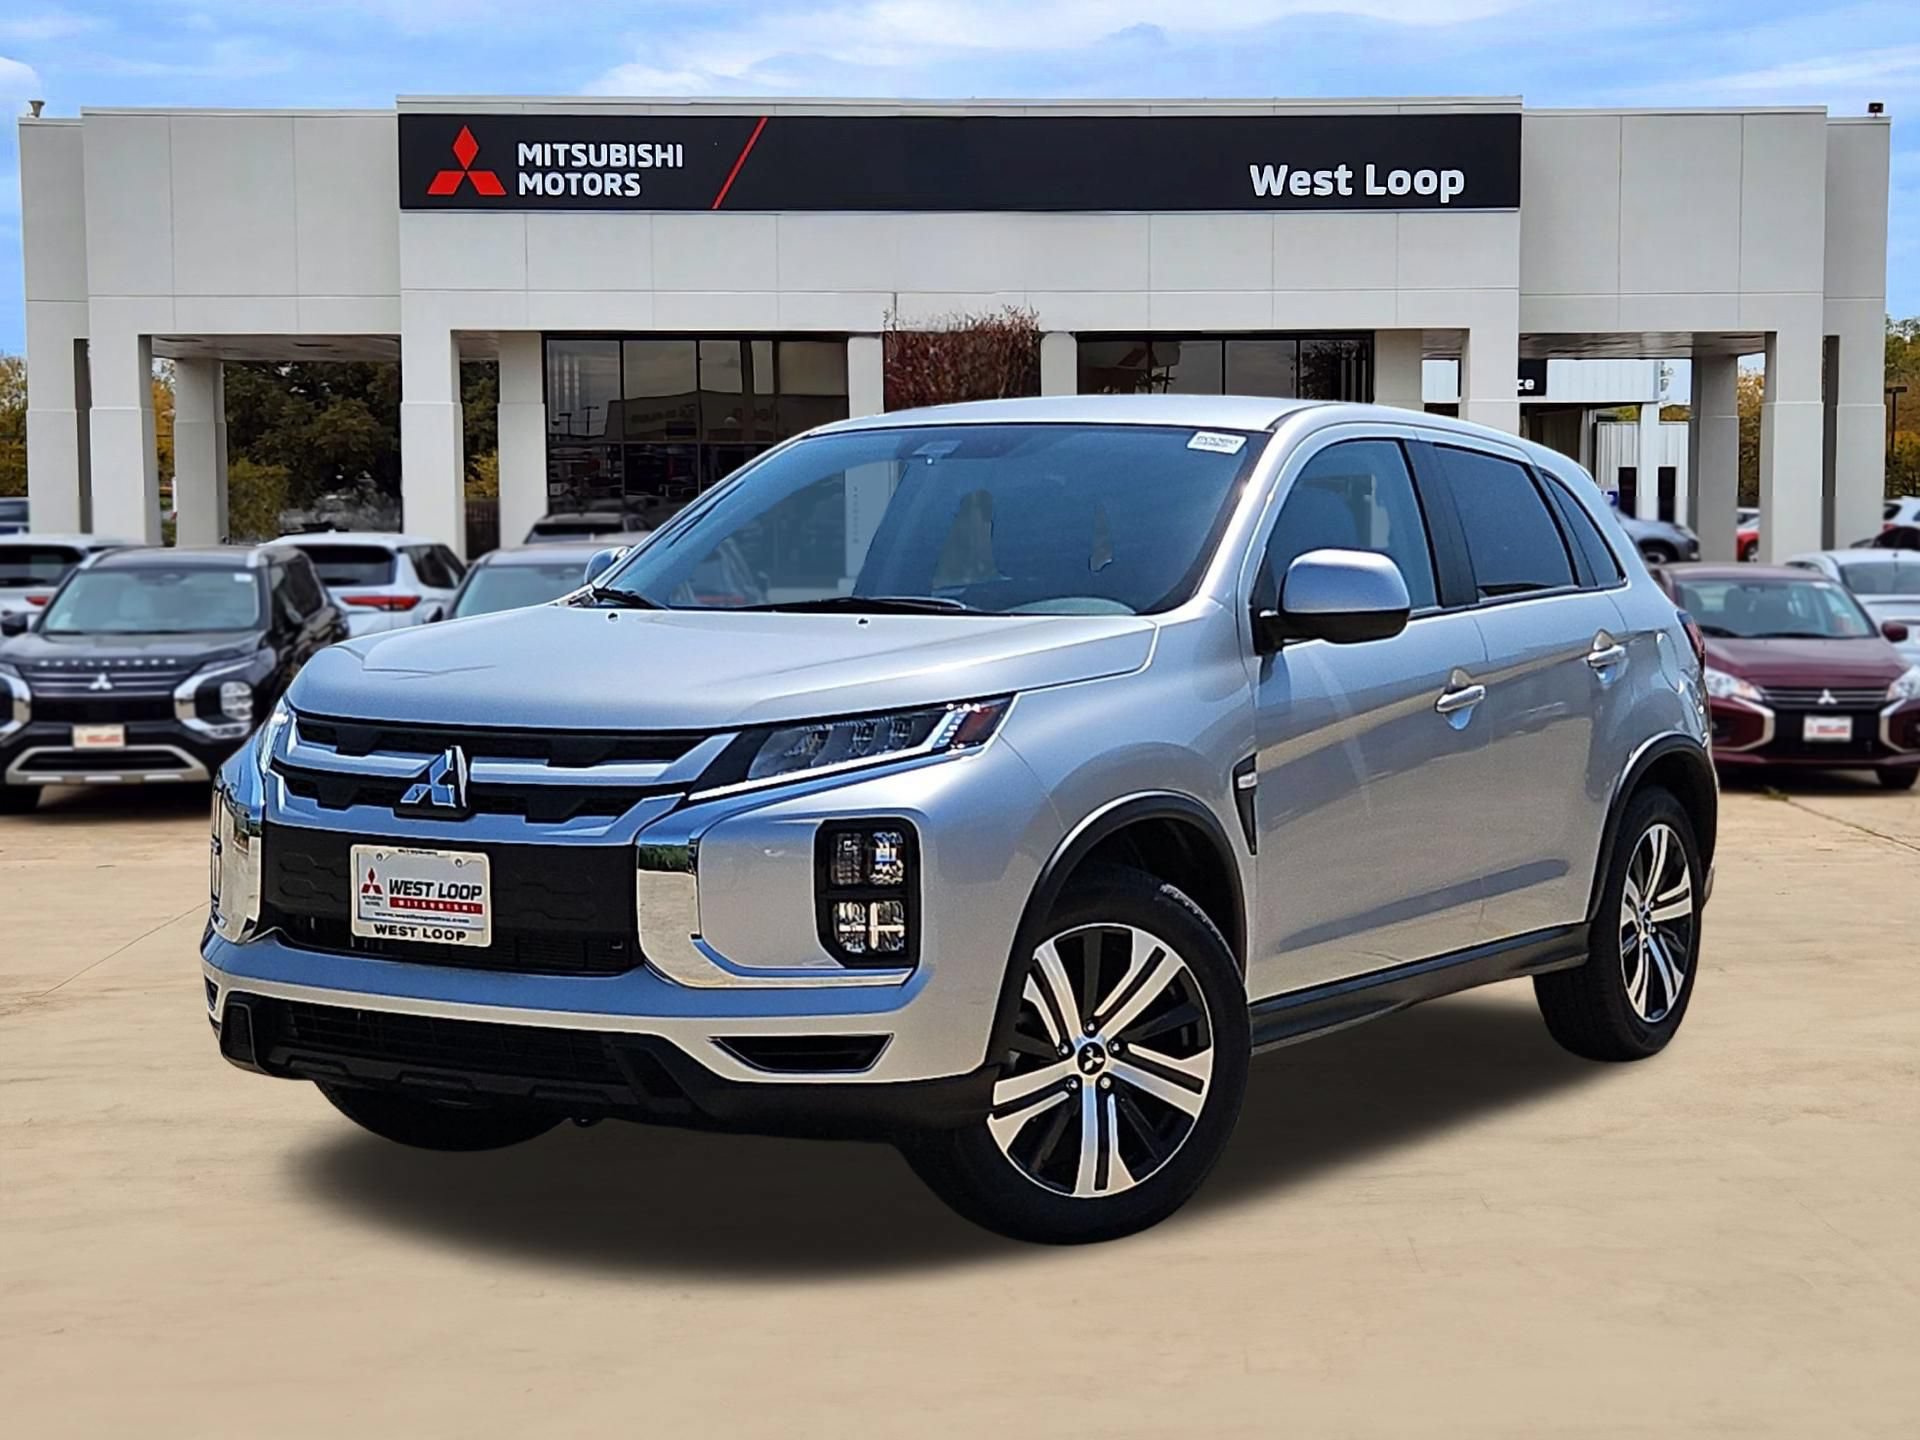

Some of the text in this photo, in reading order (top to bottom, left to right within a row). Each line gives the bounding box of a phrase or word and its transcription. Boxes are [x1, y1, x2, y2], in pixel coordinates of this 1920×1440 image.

[517, 143, 684, 168] MITSUBISHI
[517, 172, 642, 197] MOTORS
[1249, 164, 1465, 204] West Loop
[388, 878, 483, 901] WEST LOOP
[373, 923, 467, 942] WEST LOOP
